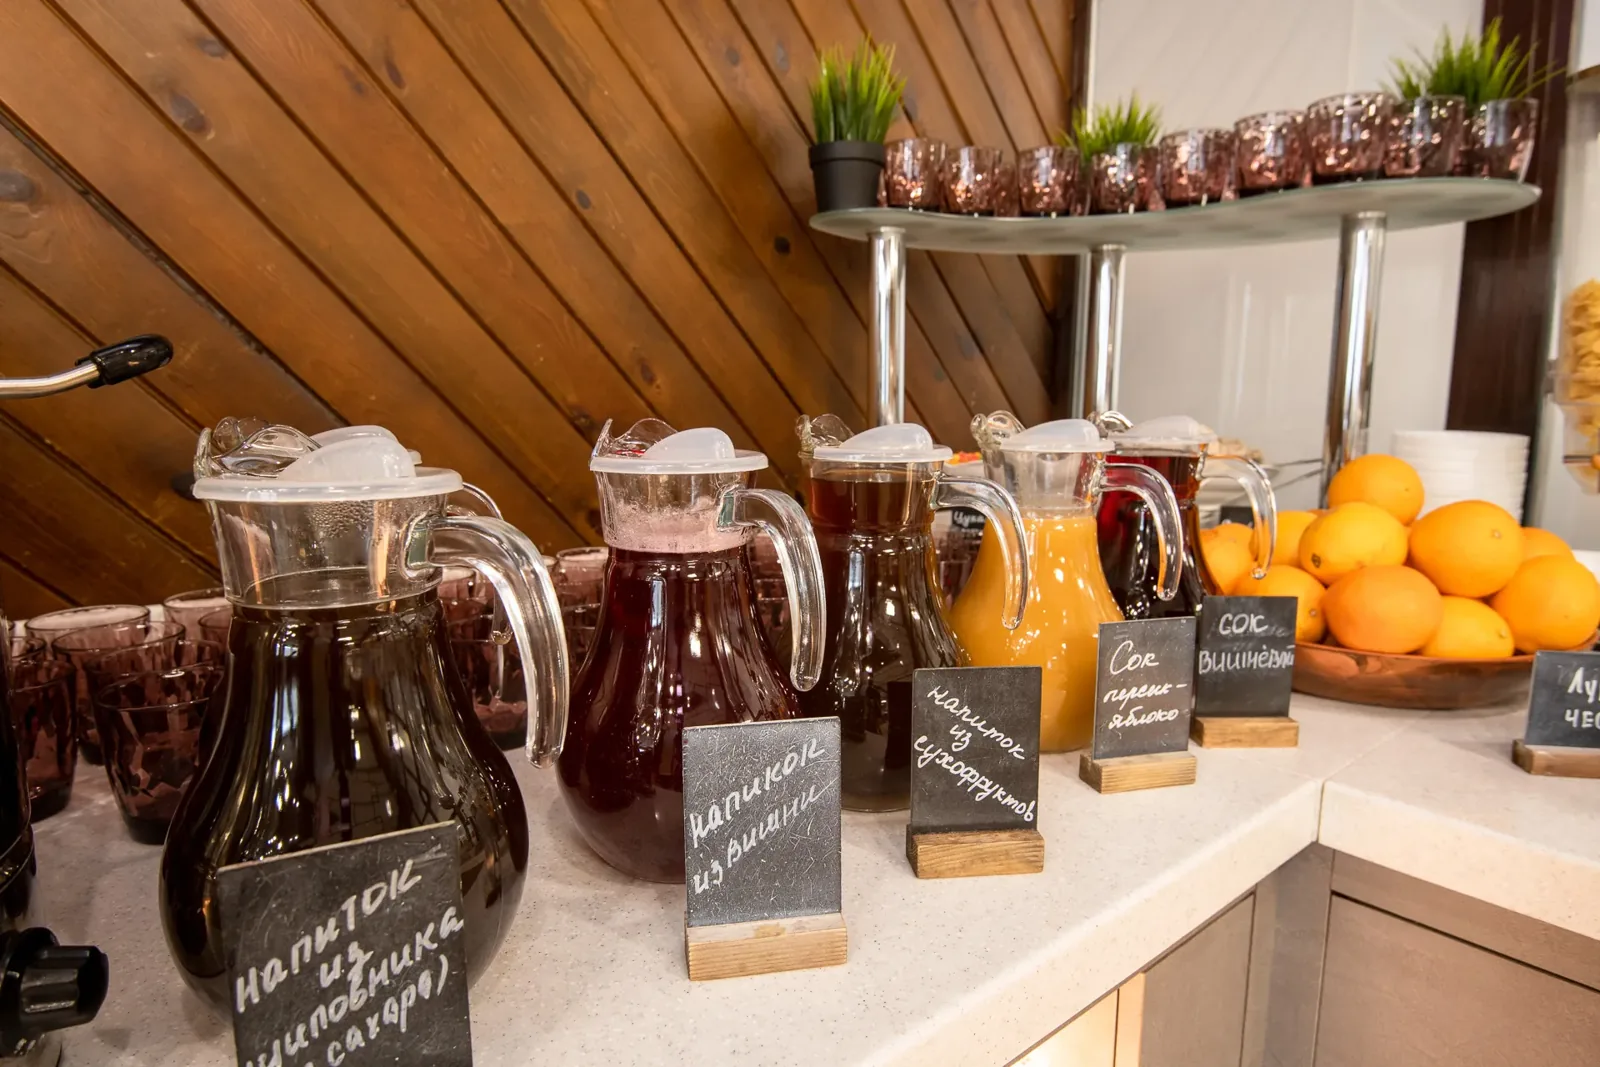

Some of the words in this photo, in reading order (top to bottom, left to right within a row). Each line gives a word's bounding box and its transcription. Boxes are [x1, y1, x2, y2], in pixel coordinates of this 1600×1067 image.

[1108, 705, 1179, 730] яблоко
[950, 724, 972, 752] из
[913, 735, 1036, 822] сухофруктов
[692, 860, 724, 895] из
[319, 941, 374, 988] из
